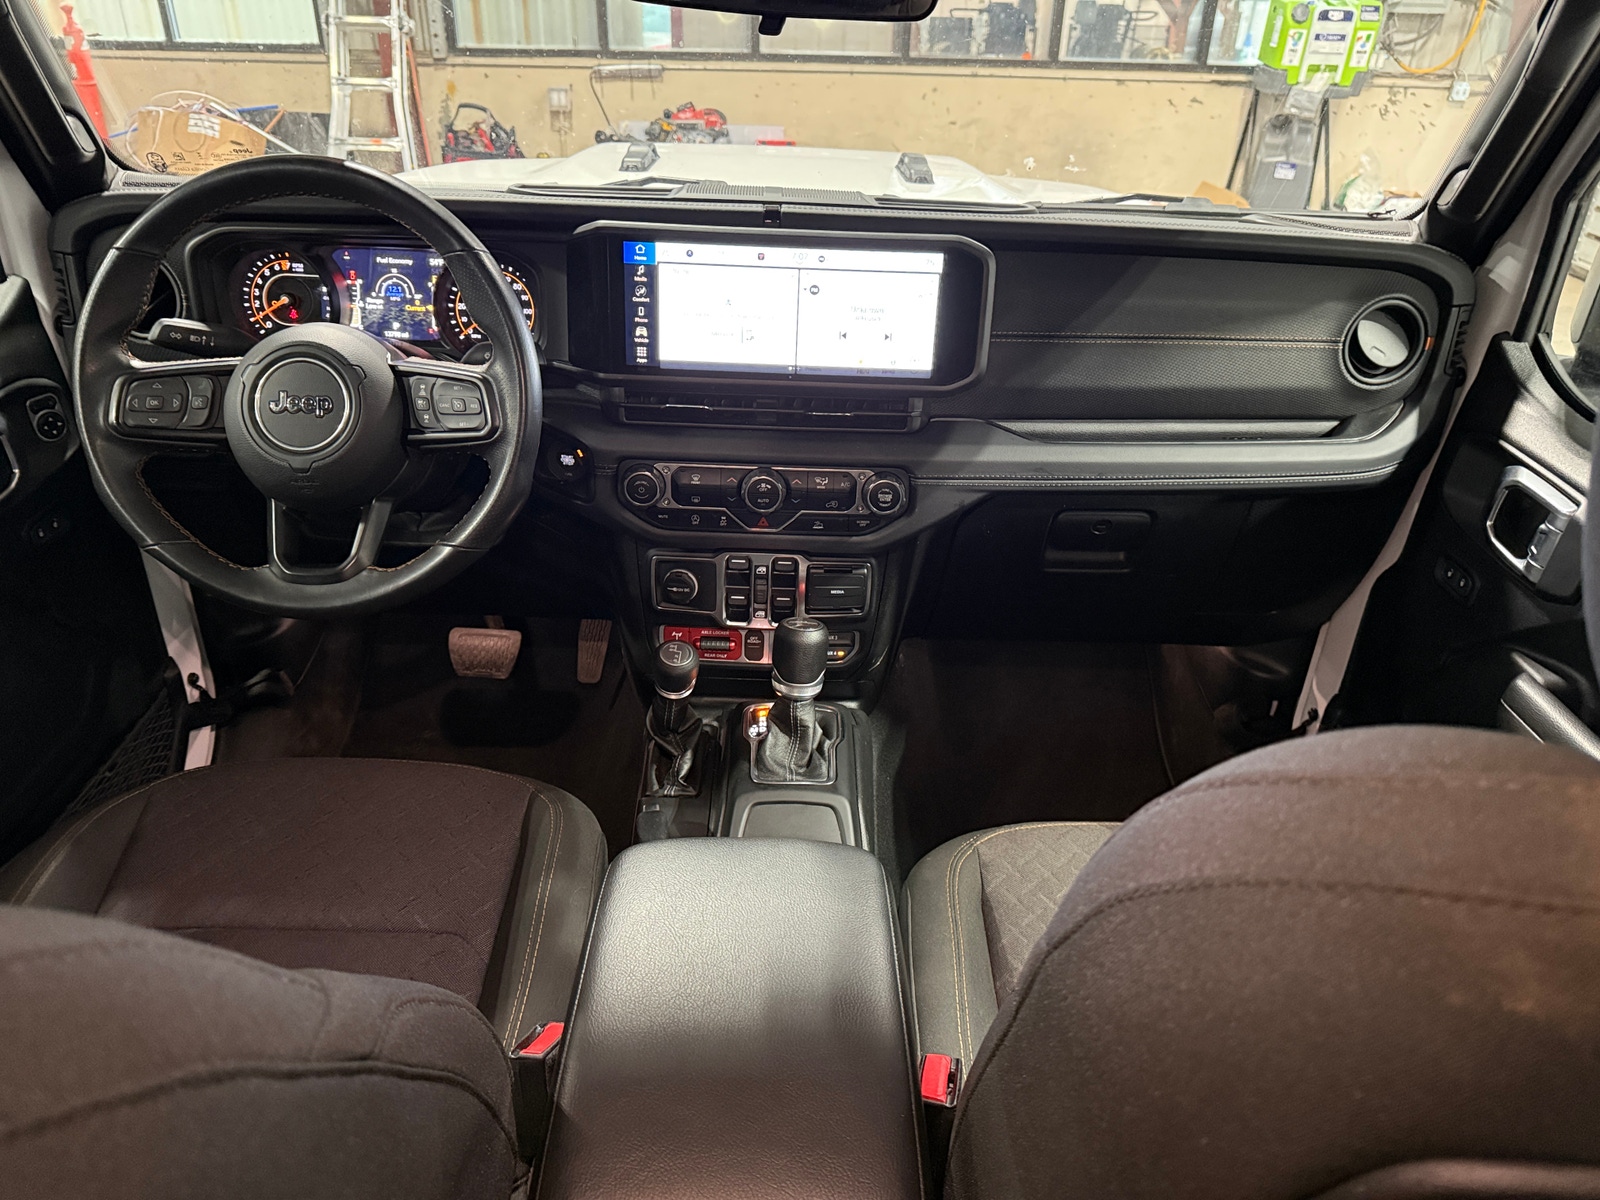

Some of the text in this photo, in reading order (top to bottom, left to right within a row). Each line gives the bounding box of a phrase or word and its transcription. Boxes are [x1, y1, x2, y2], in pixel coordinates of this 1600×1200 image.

[389, 258, 413, 266] Economy
[274, 263, 280, 271] 6
[255, 300, 261, 308] 2
[266, 320, 273, 328] 0
[268, 390, 333, 419] Jeep
